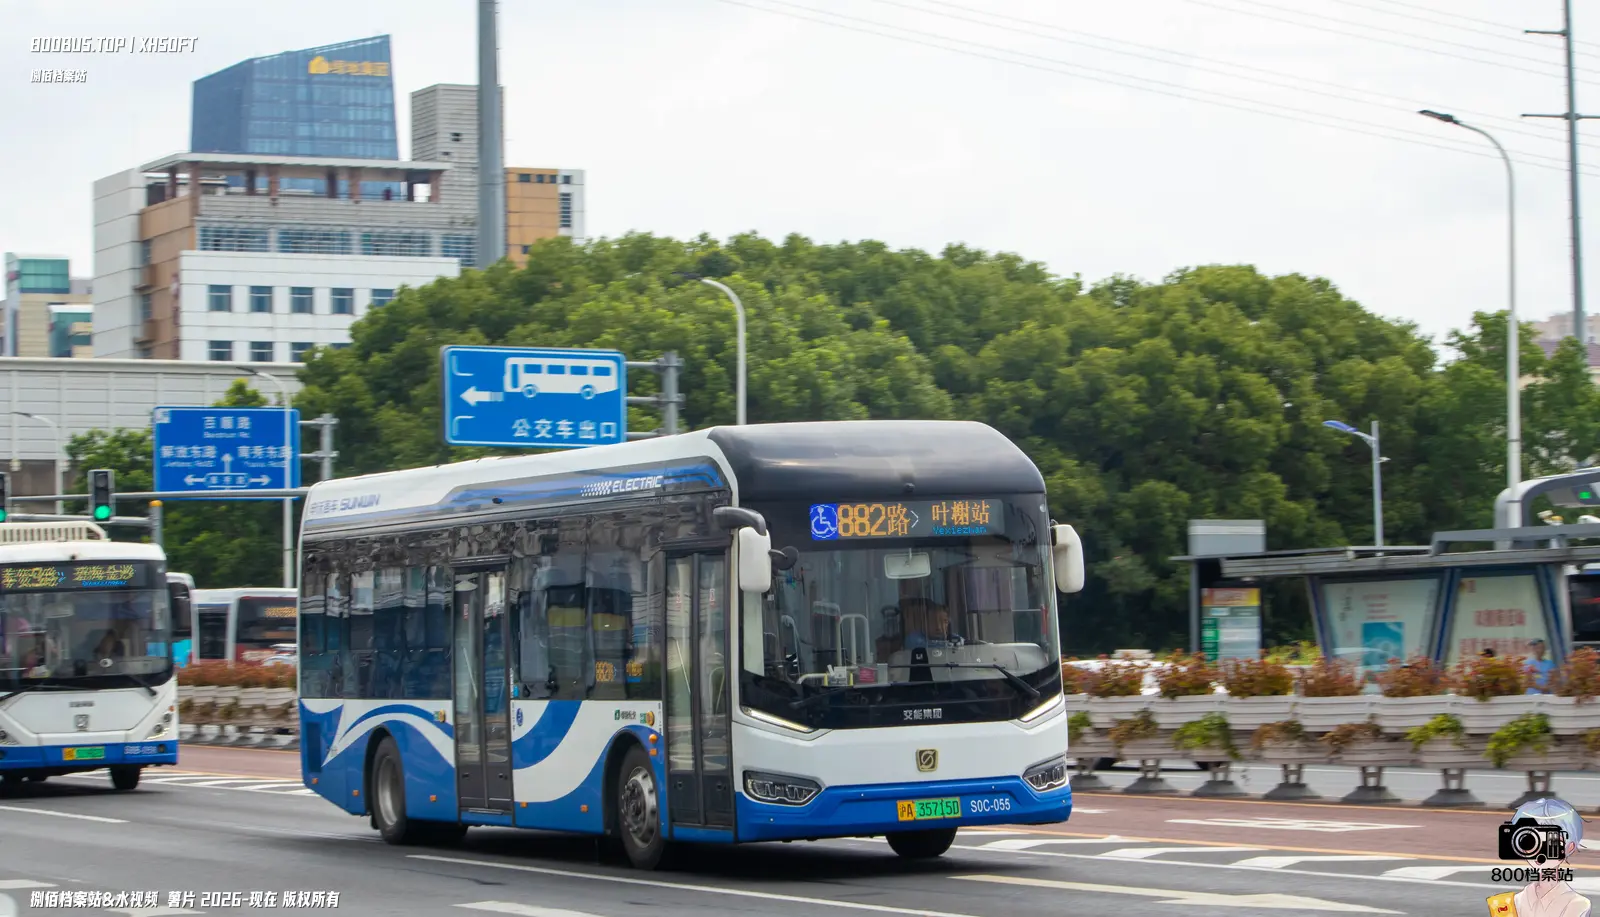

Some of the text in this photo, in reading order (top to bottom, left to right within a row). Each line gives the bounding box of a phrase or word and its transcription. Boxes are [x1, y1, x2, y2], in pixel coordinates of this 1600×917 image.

[511, 418, 617, 440] 公交车出口
[612, 475, 664, 493] ELECTRIC
[837, 500, 990, 537] 882路 叶榭站
[903, 708, 942, 720] 交能集团
